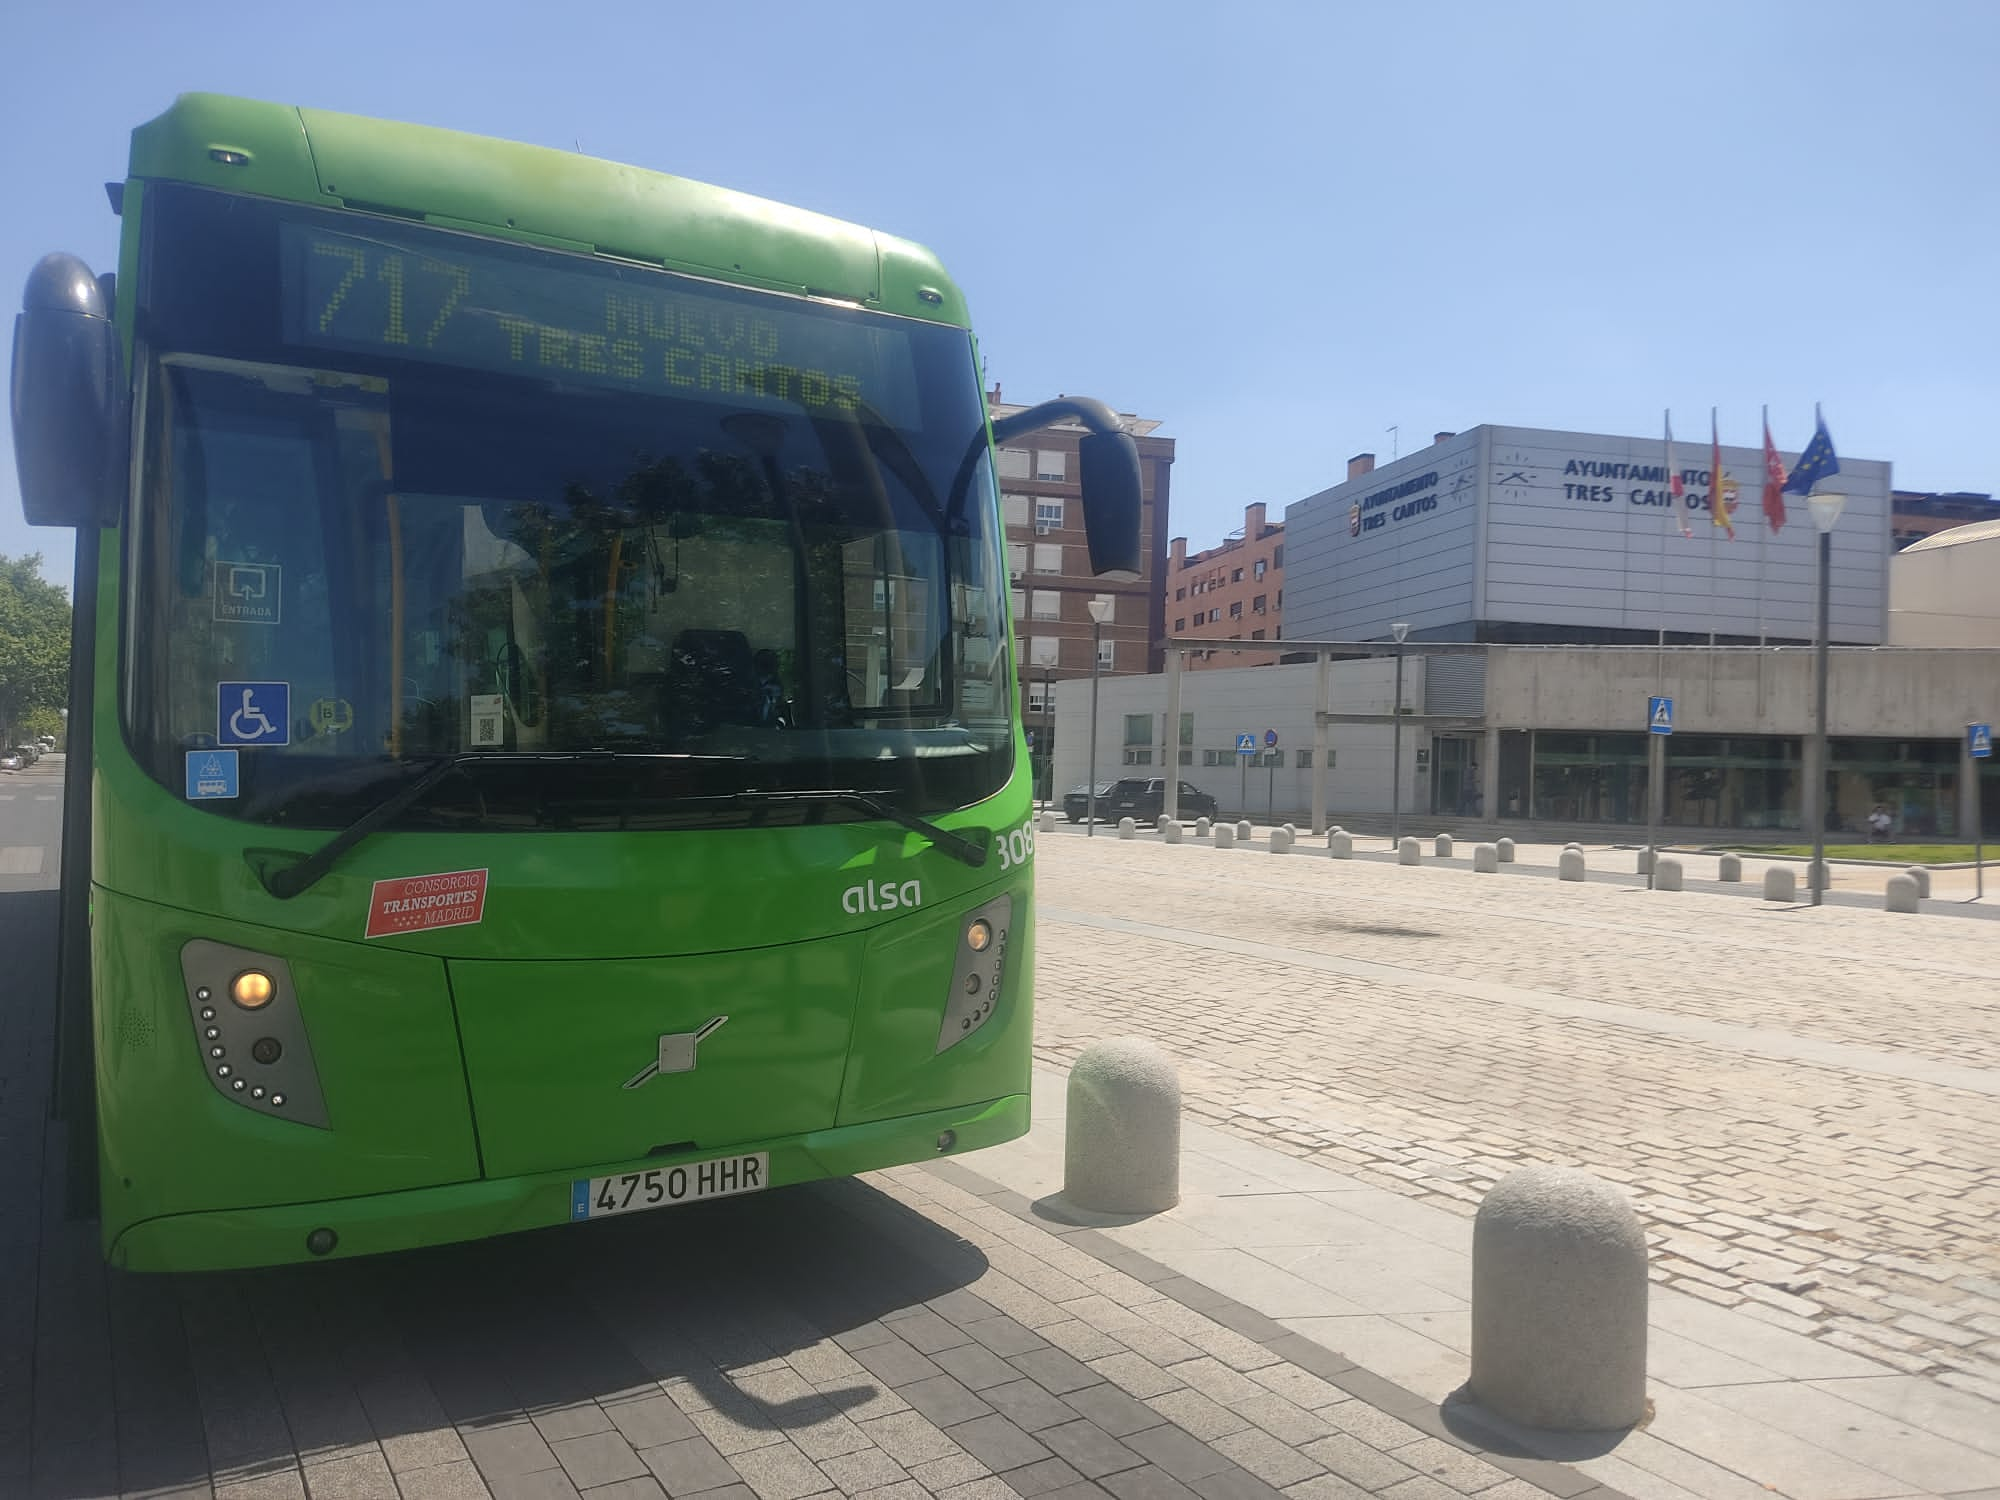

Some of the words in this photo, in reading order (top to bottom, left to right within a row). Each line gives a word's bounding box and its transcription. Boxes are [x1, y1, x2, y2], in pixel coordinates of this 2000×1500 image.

[313, 241, 471, 348] 717
[606, 296, 779, 357] NUEVO
[499, 317, 645, 379] TRES
[664, 347, 861, 410] CANTOS
[1362, 511, 1386, 532] TRES
[1392, 493, 1438, 521] CANTOS
[1563, 483, 1614, 503] TRES
[1630, 488, 1712, 511] CANOS
[223, 604, 272, 617] ENTRADA
[404, 874, 481, 896] CONSORCIO
[842, 879, 922, 914] alsa
[383, 889, 478, 915] TRANSPORTES
[423, 905, 475, 925] MADRID
[596, 1167, 688, 1210] 4750
[697, 1156, 761, 1195] HHR
[577, 1203, 585, 1214] E
